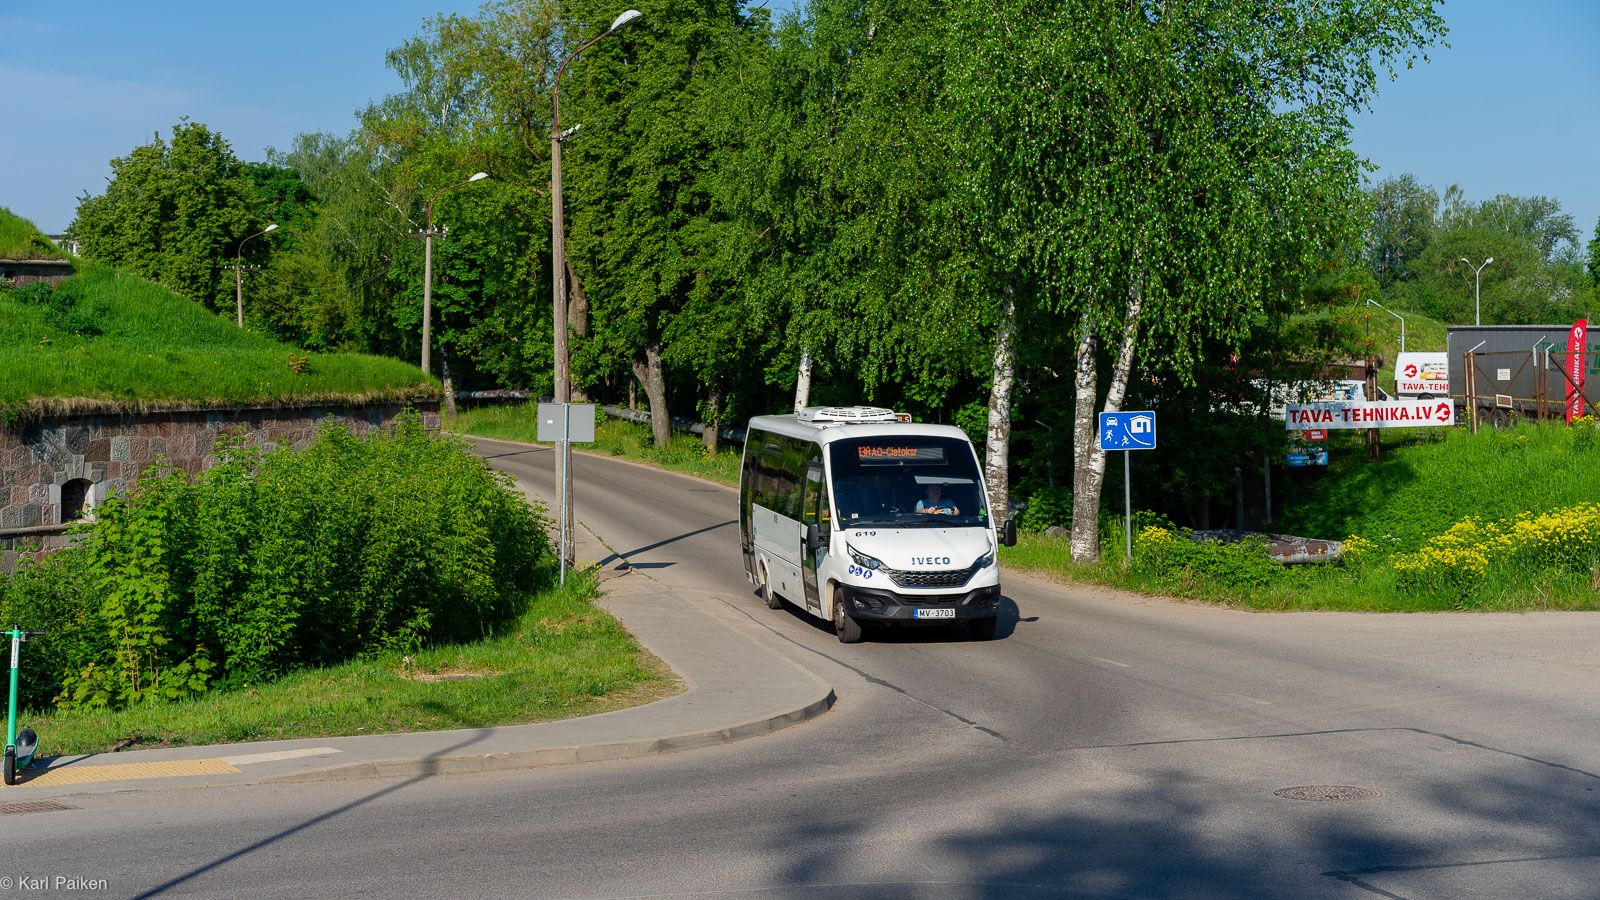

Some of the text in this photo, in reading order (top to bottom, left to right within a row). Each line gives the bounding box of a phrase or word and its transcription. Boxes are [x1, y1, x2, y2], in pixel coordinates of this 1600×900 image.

[1289, 406, 1433, 423] TAVA-TEHNIKA.LV
[911, 557, 951, 566] IVECO
[919, 609, 954, 618] MV-3703
